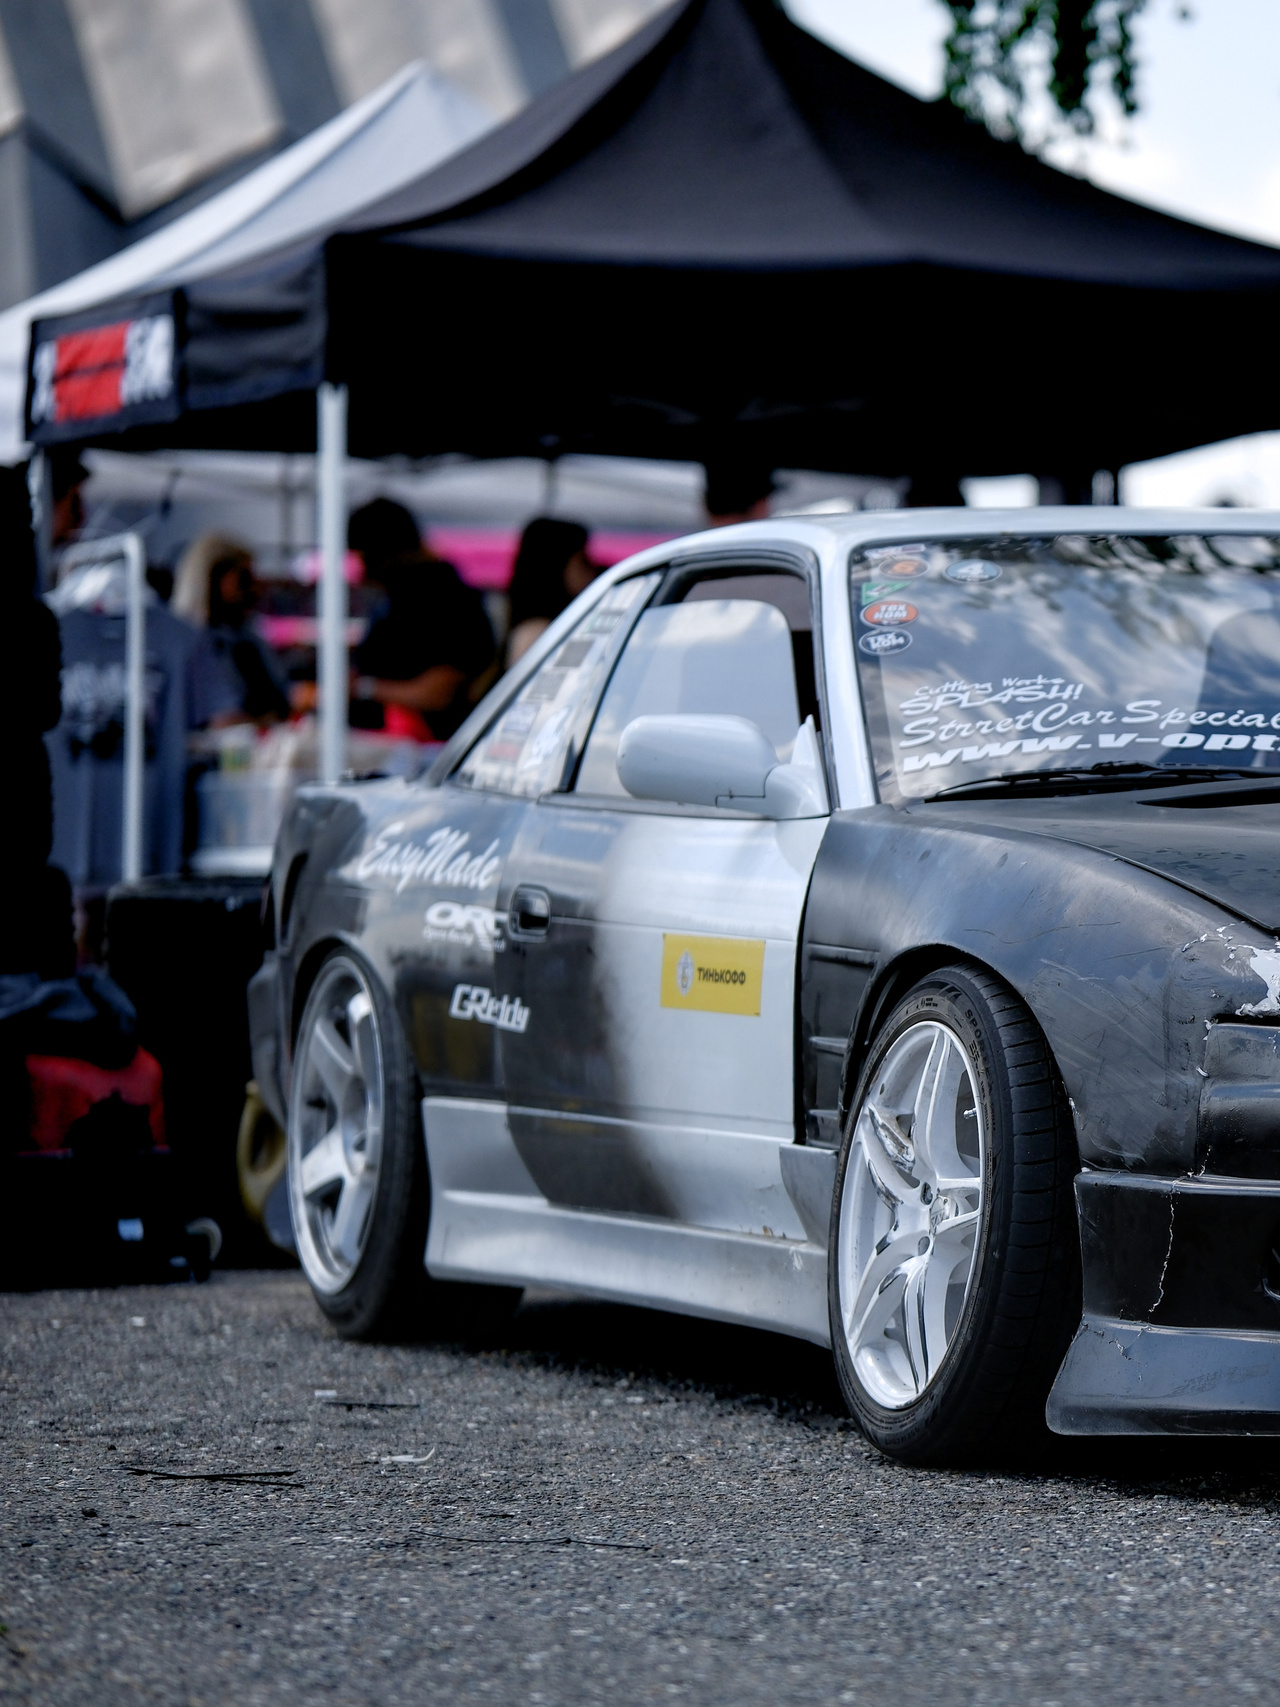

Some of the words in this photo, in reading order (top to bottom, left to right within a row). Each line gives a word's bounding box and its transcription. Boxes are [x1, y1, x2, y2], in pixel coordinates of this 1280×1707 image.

[898, 683, 1085, 717] SPLASH!
[914, 679, 993, 697] Cutting
[697, 966, 747, 986] ТИНЬКОФФ
[449, 983, 531, 1034] GReddy
